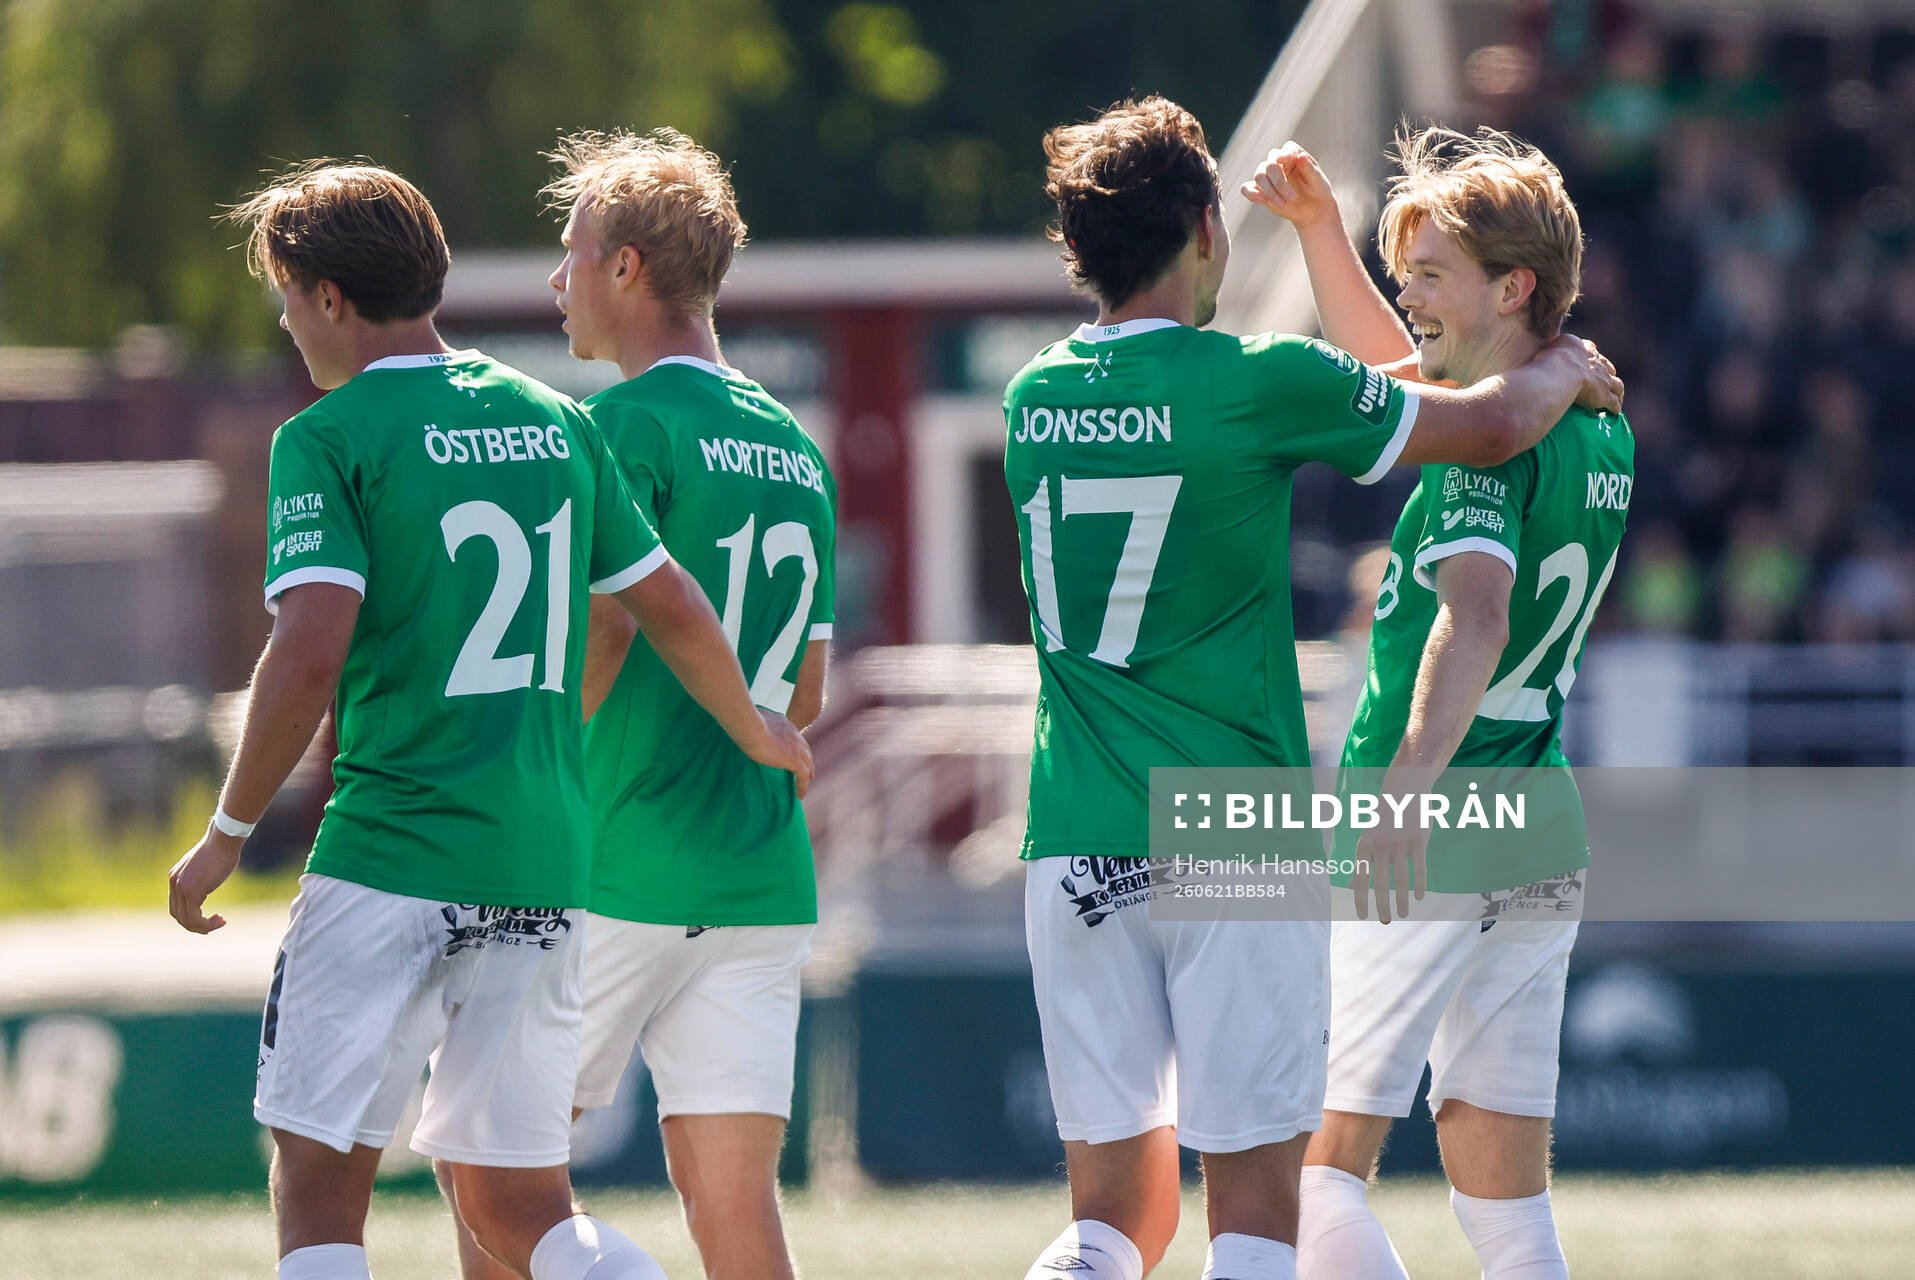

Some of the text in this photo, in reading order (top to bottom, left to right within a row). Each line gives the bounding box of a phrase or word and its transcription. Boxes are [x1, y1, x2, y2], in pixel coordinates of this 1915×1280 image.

[1103, 326, 1121, 336] 1925
[1357, 367, 1380, 413] UNIB
[424, 423, 571, 464] ÖSTBERG
[1014, 406, 1172, 444] JONSSON
[698, 437, 825, 495] MORTENSE
[283, 493, 324, 515] LYKTA
[1464, 473, 1506, 498] LYKTA
[1585, 471, 1634, 510] NORD
[1465, 516, 1505, 534] SPORT
[1466, 506, 1505, 524] INTER
[286, 540, 322, 557] SPORT
[287, 530, 322, 547] INTER
[1021, 475, 1183, 668] 17
[440, 498, 571, 697] 21
[716, 513, 818, 715] 12
